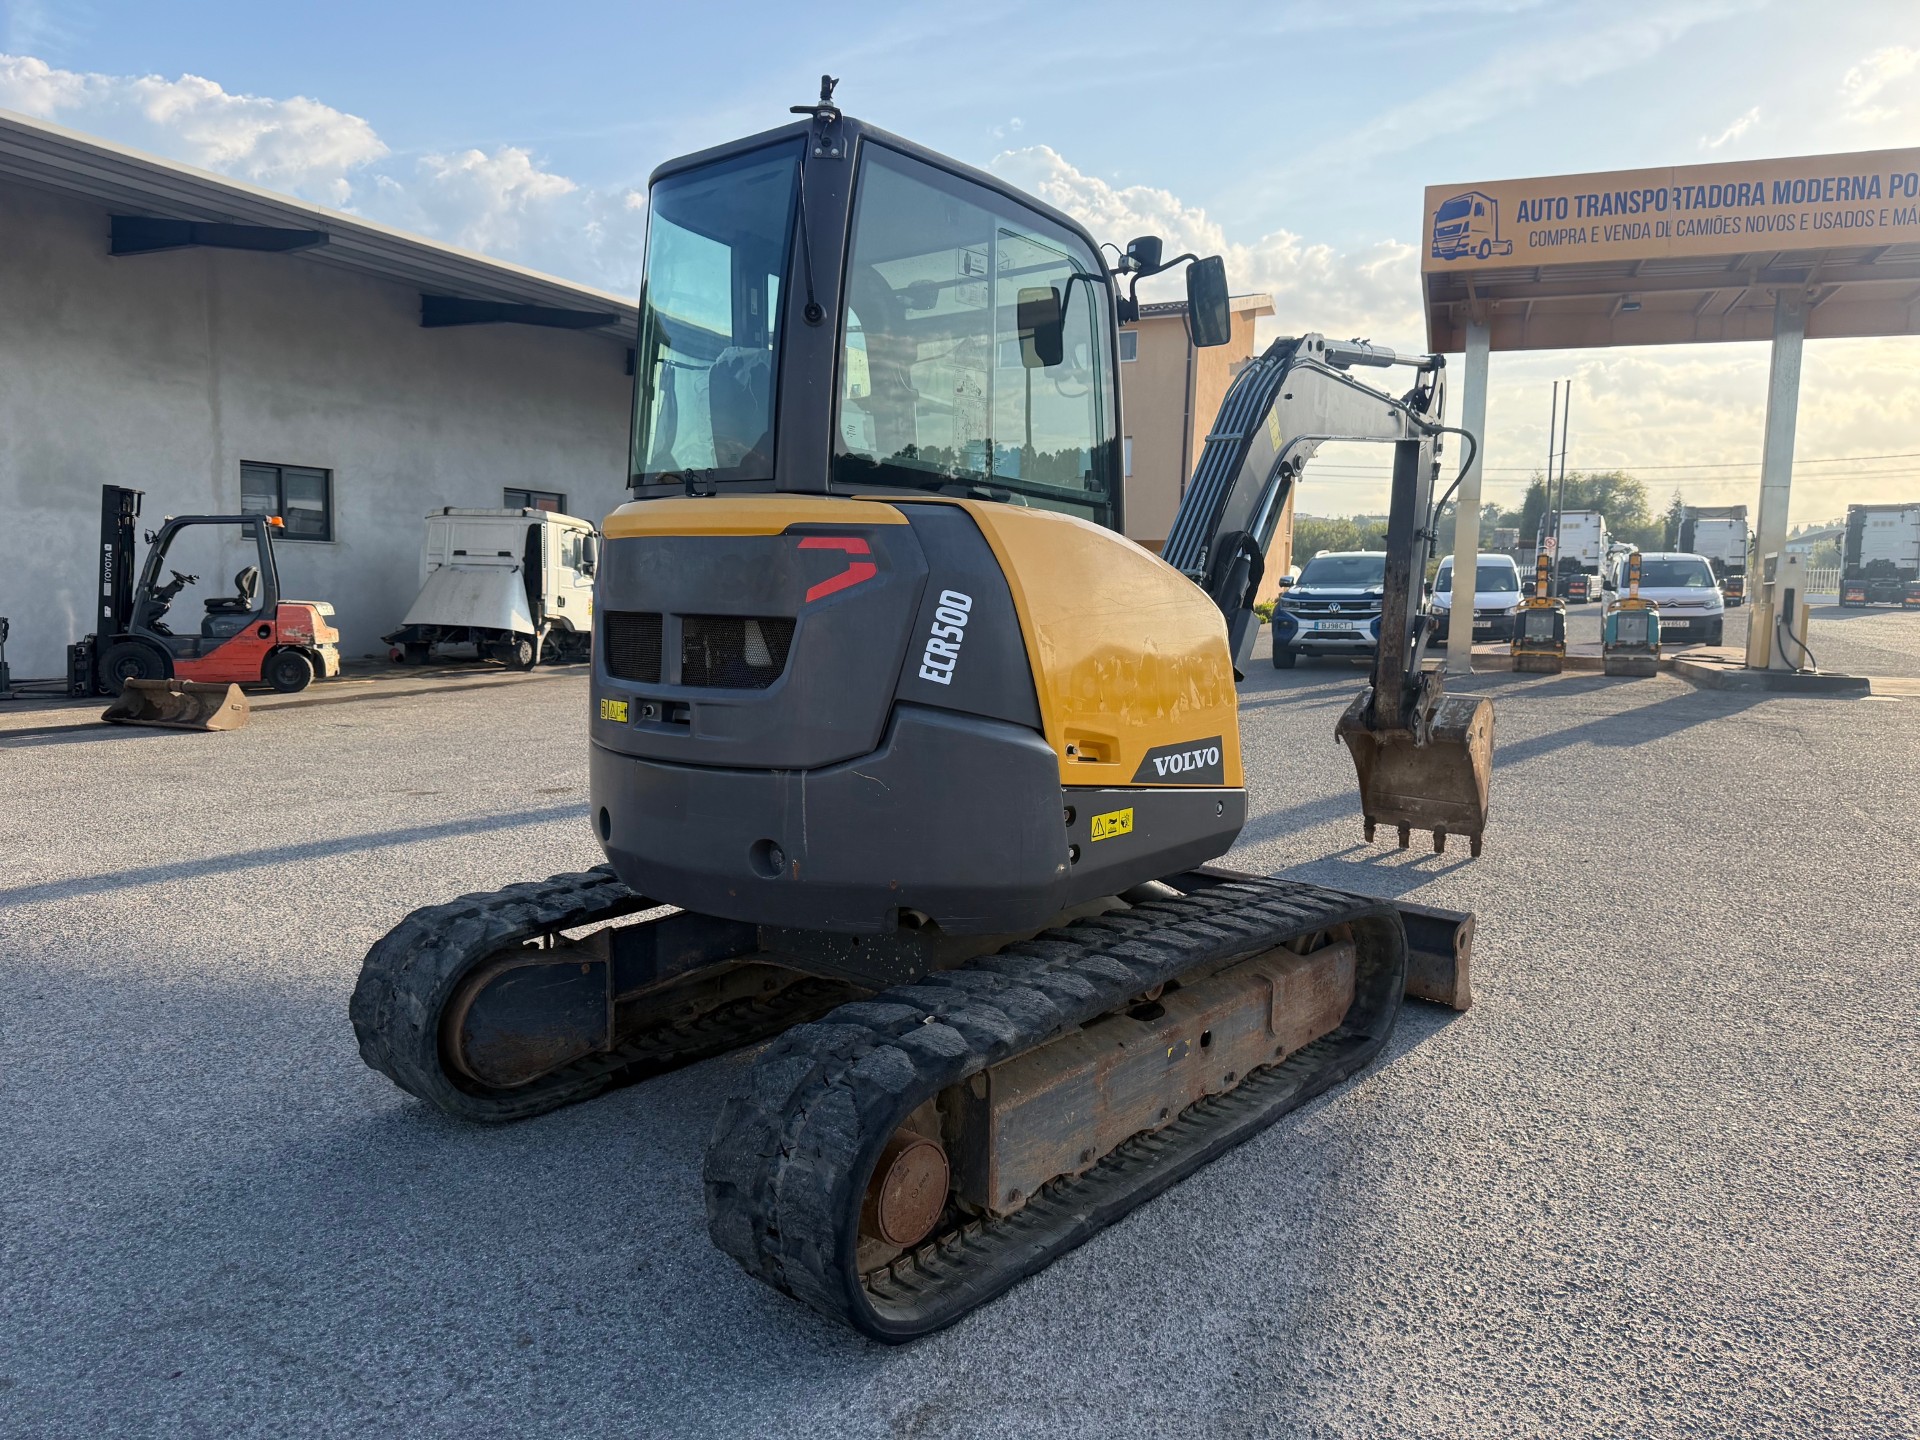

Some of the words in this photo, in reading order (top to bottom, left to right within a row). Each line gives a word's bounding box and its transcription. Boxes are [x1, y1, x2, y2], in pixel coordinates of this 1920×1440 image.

[1516, 197, 1569, 223] AUTO
[1574, 182, 1765, 218] TRANSPORTADORA
[1771, 174, 1882, 205] MODERNA
[1888, 172, 1920, 199] PO
[1529, 227, 1587, 247] COMPRA
[1591, 226, 1599, 243] E
[1603, 223, 1651, 242] VENDA
[1676, 214, 1741, 237] CAMIÕES
[1745, 212, 1796, 233] NOVOS
[1799, 213, 1809, 231] E
[1813, 209, 1875, 229] USADOS
[1879, 208, 1889, 226] E
[1893, 204, 1920, 226] MÁ
[104, 552, 112, 582] TOYOTA
[918, 589, 973, 685] ECR50D
[1153, 746, 1220, 777] VOLVO
